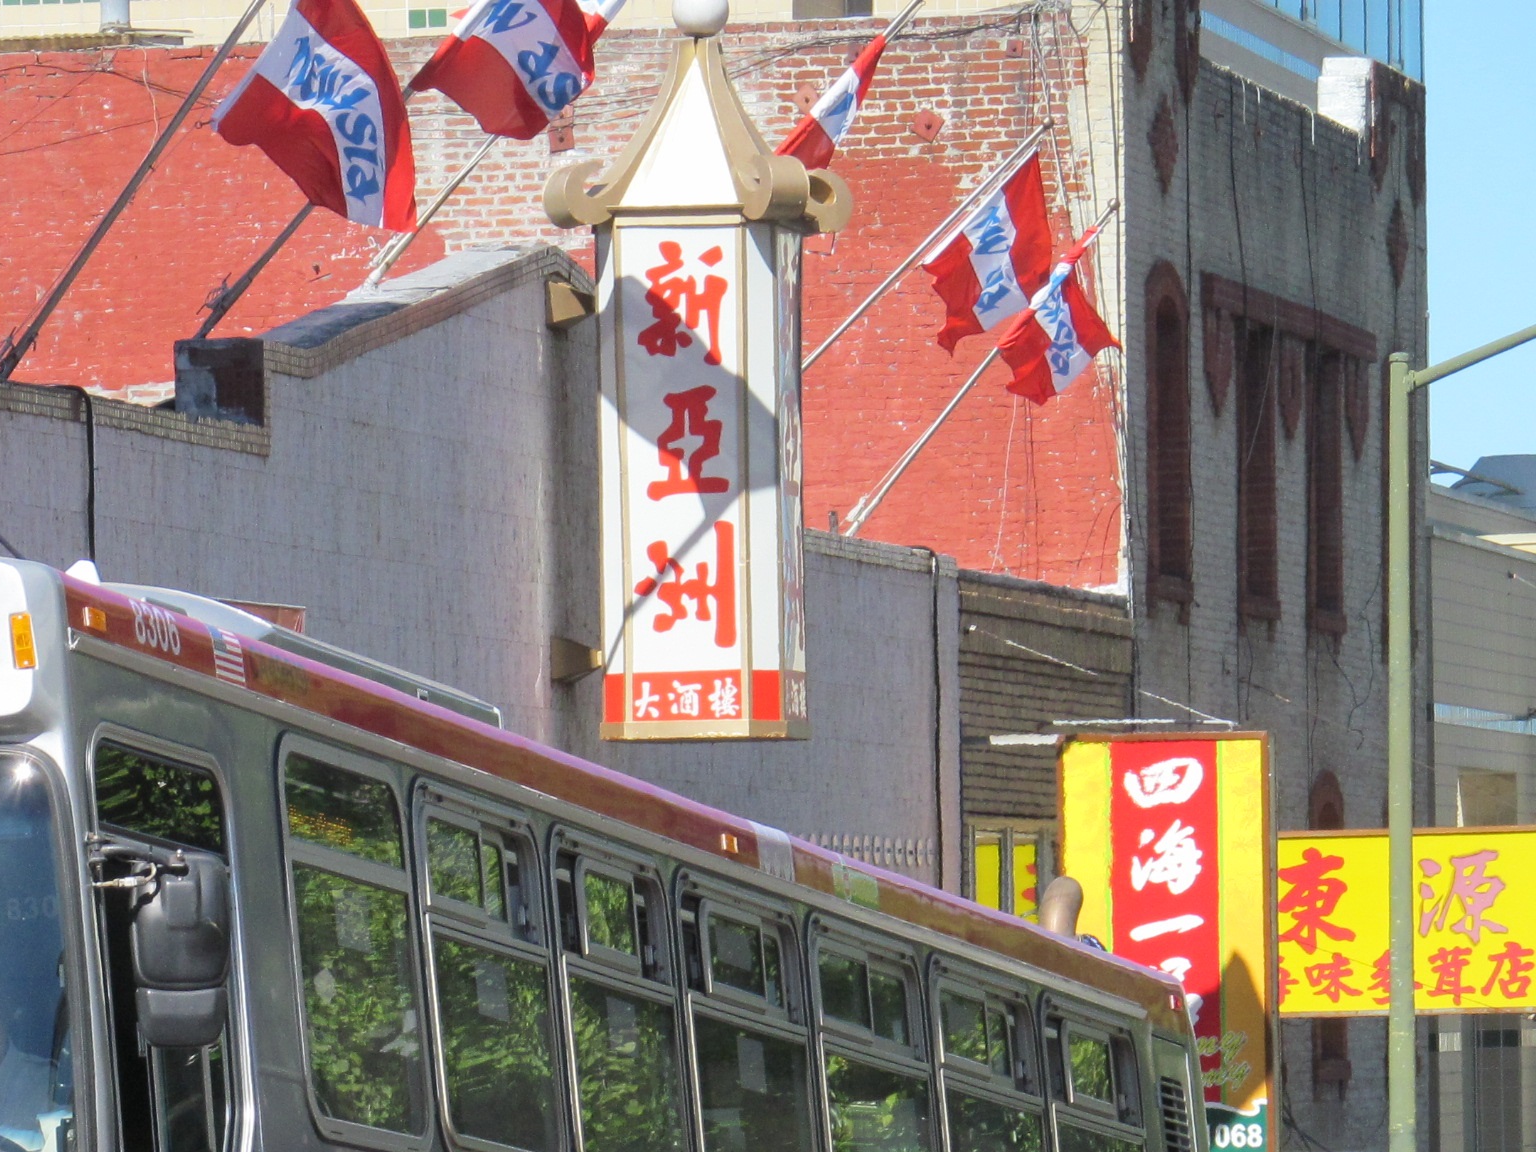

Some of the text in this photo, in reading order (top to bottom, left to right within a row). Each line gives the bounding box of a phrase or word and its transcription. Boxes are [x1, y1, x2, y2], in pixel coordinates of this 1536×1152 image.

[636, 240, 738, 649] 新亞洲
[129, 598, 182, 656] 8306
[634, 677, 740, 718] 大酒樓
